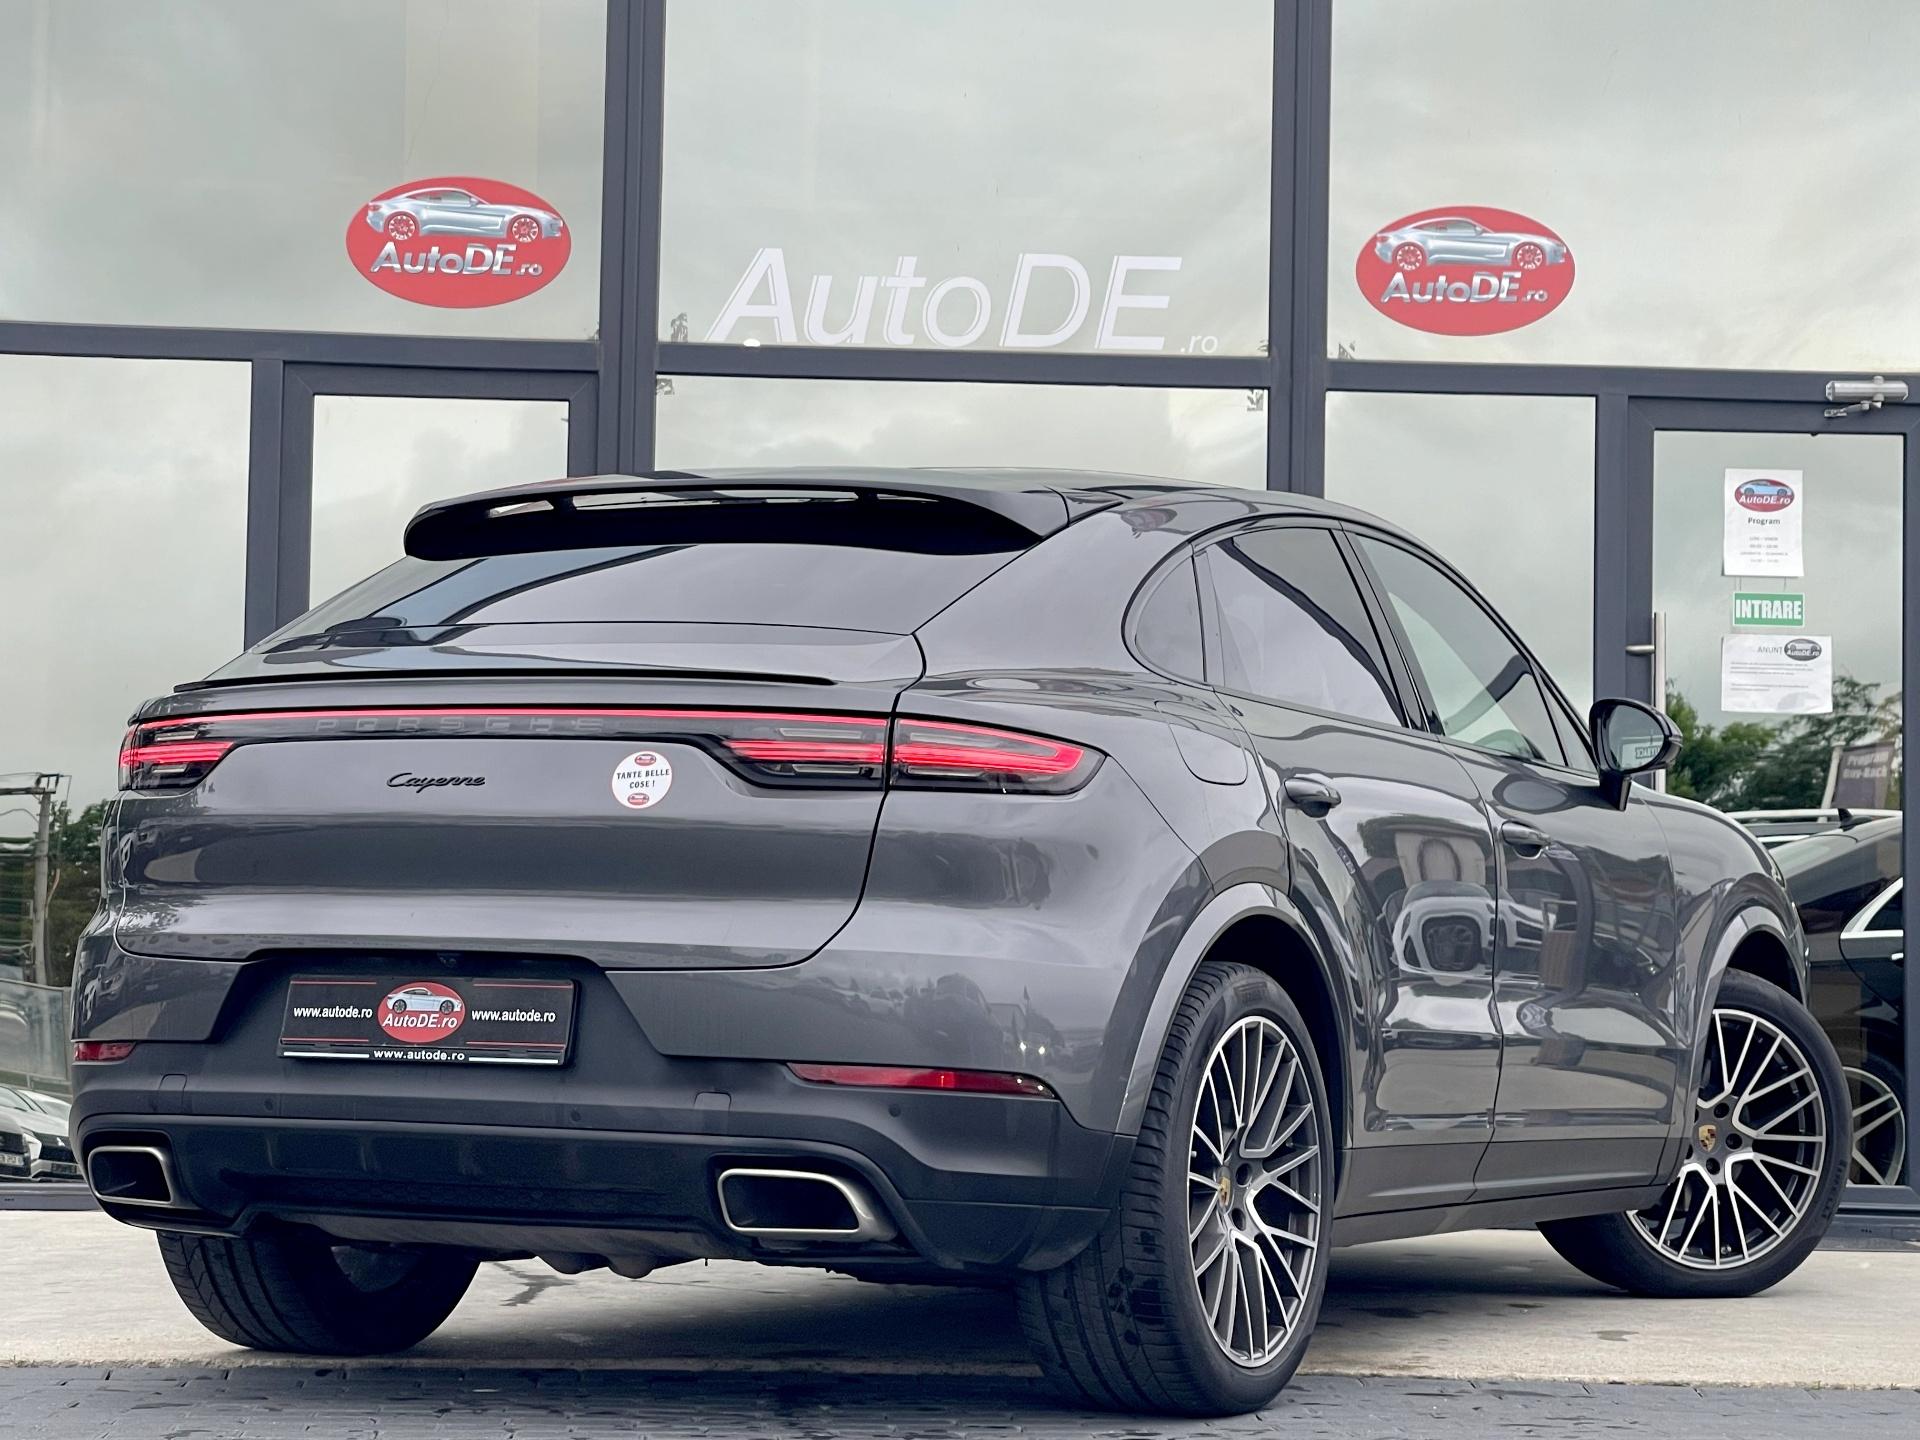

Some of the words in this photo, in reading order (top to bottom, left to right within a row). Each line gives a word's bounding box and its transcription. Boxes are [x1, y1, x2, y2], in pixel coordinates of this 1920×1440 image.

[1747, 516, 1781, 526] Program
[1735, 598, 1802, 620] INTRARE
[616, 770, 643, 780] TANTE
[645, 768, 670, 778] BELLE
[386, 772, 486, 794] Cayenne
[629, 780, 650, 789] COSE
[292, 1005, 373, 1020] www.autode.ro
[471, 1008, 556, 1023] www.autode.ro
[381, 1012, 458, 1030] AutoDE.ro
[373, 1049, 465, 1062] www.autode.ro
